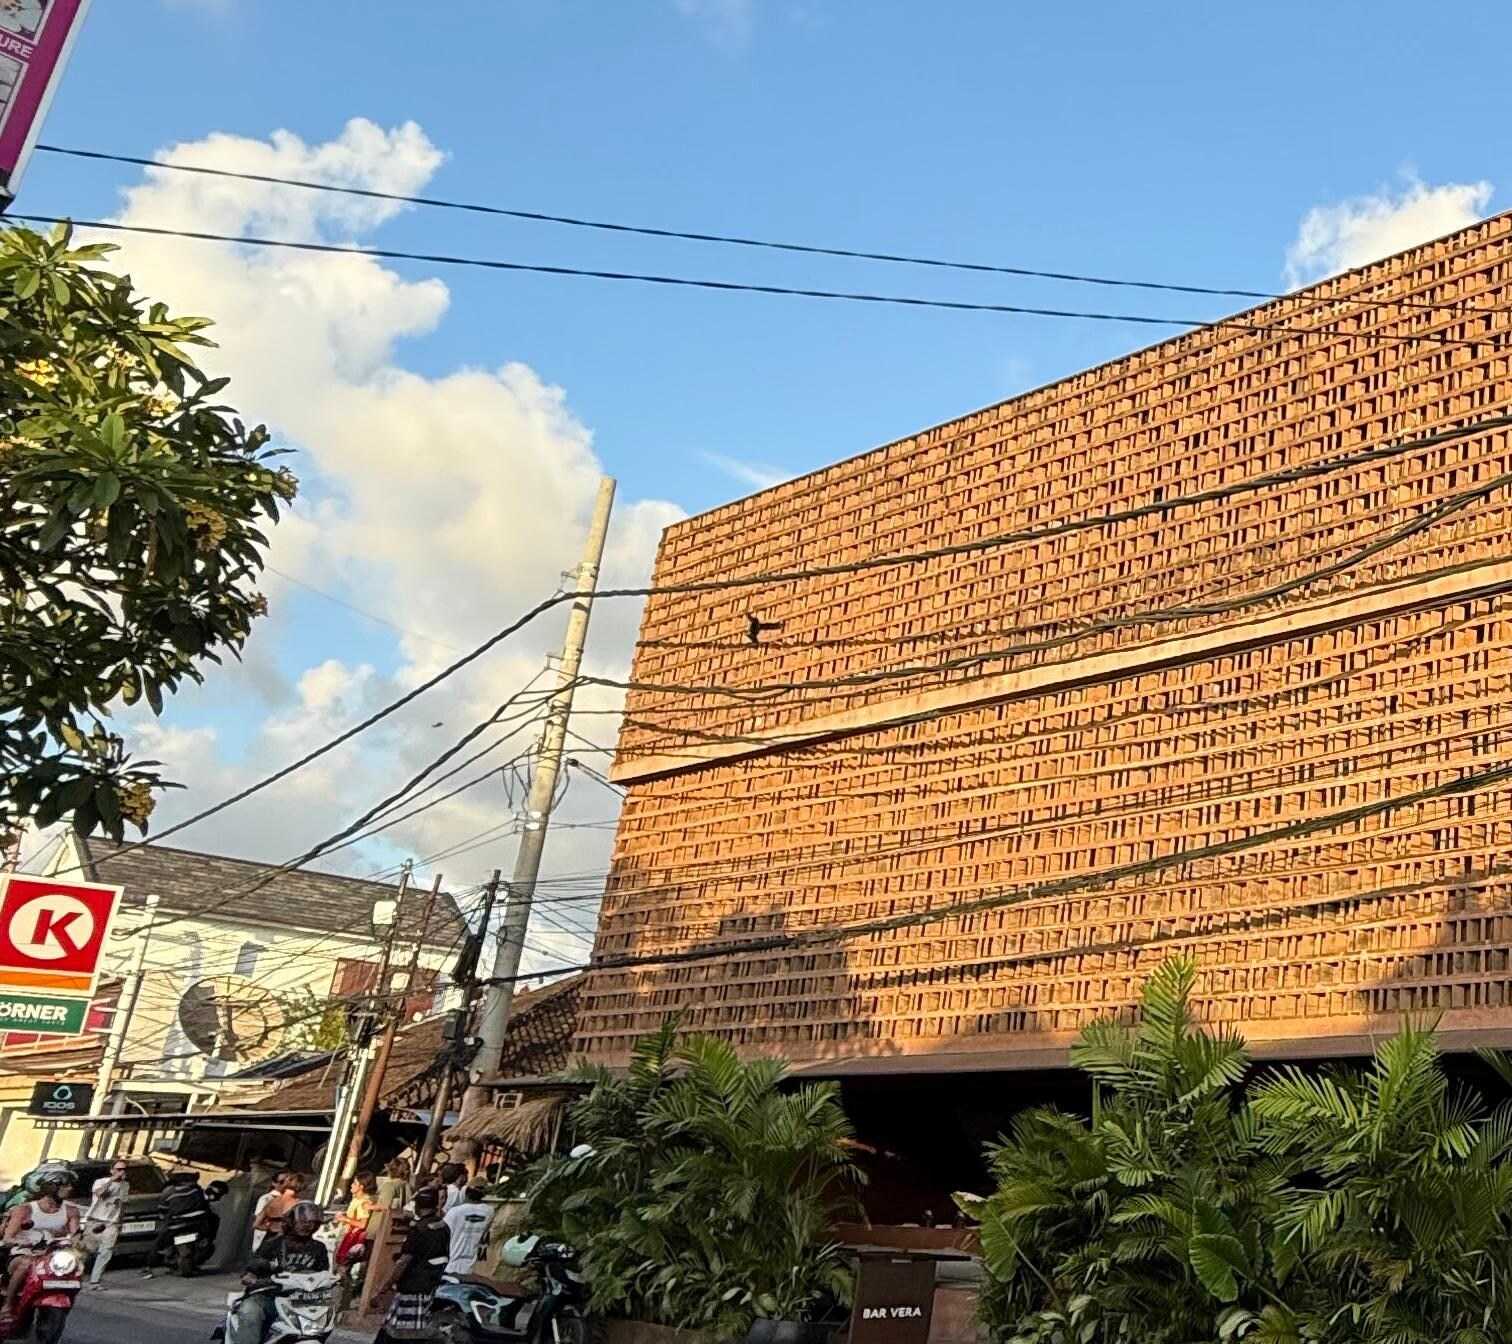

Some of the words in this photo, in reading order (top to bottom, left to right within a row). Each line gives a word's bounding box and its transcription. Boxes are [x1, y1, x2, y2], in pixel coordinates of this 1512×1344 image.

[30, 908, 84, 959] K
[863, 1308, 887, 1319] BAR
[890, 1306, 921, 1318] VERA
